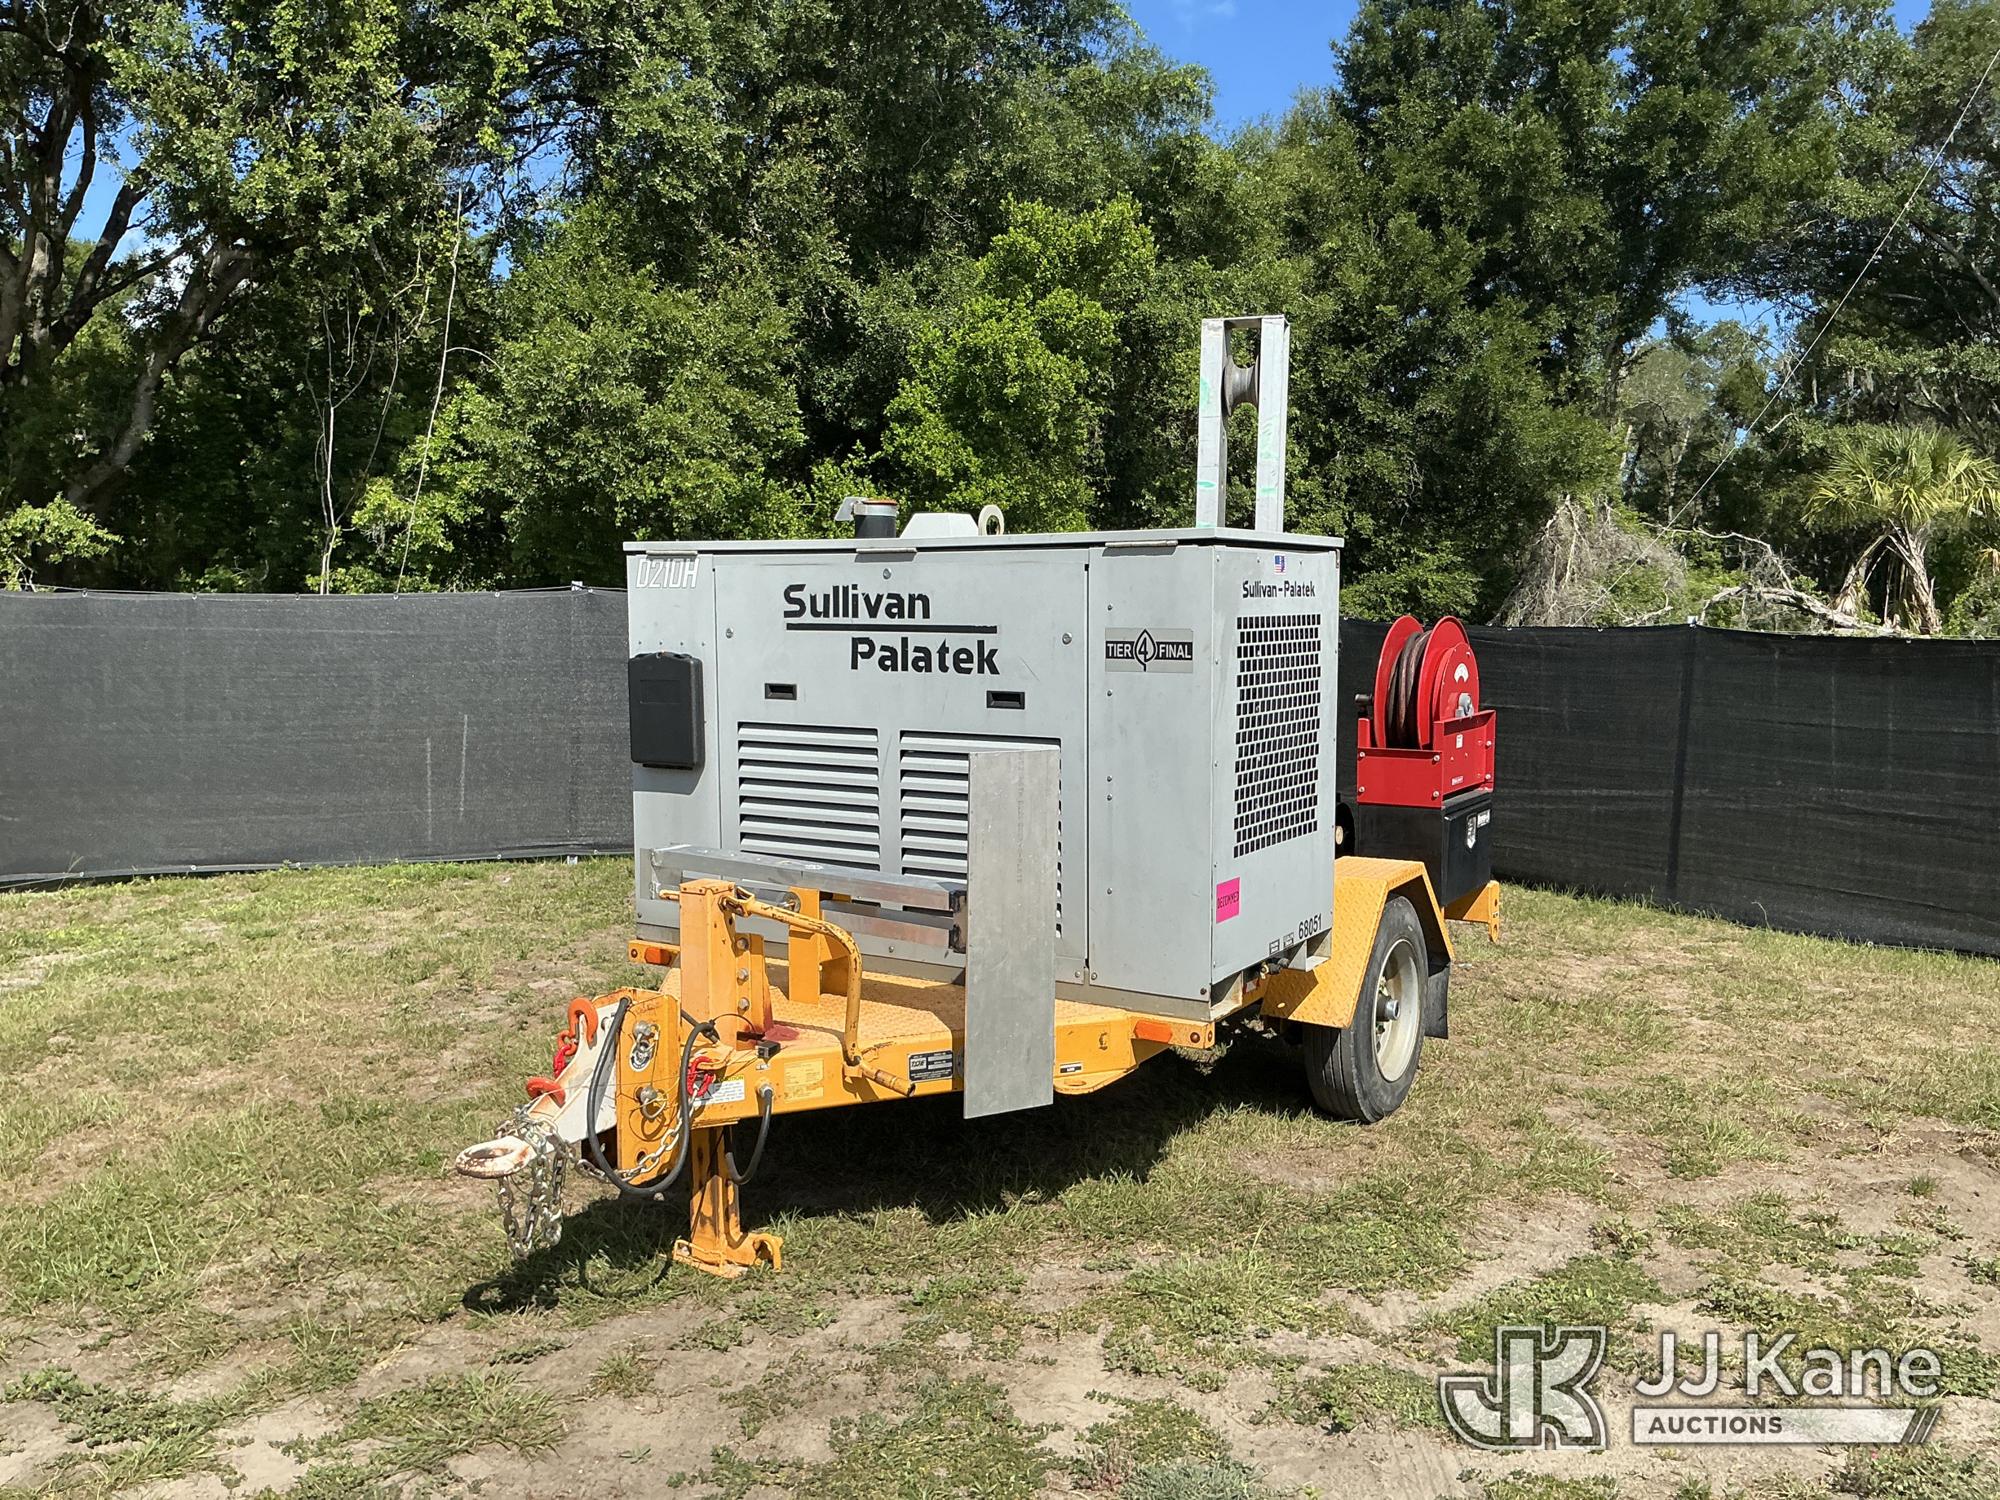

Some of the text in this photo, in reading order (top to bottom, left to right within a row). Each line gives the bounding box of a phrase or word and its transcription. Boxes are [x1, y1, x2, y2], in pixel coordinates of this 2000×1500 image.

[783, 583, 931, 619] Sullivan
[1242, 580, 1315, 599] Sullivan-Palatek
[850, 636, 1000, 675] Palatek
[1107, 642, 1132, 659] TIER
[1158, 643, 1192, 658] FINAL
[1298, 913, 1322, 940] 68051
